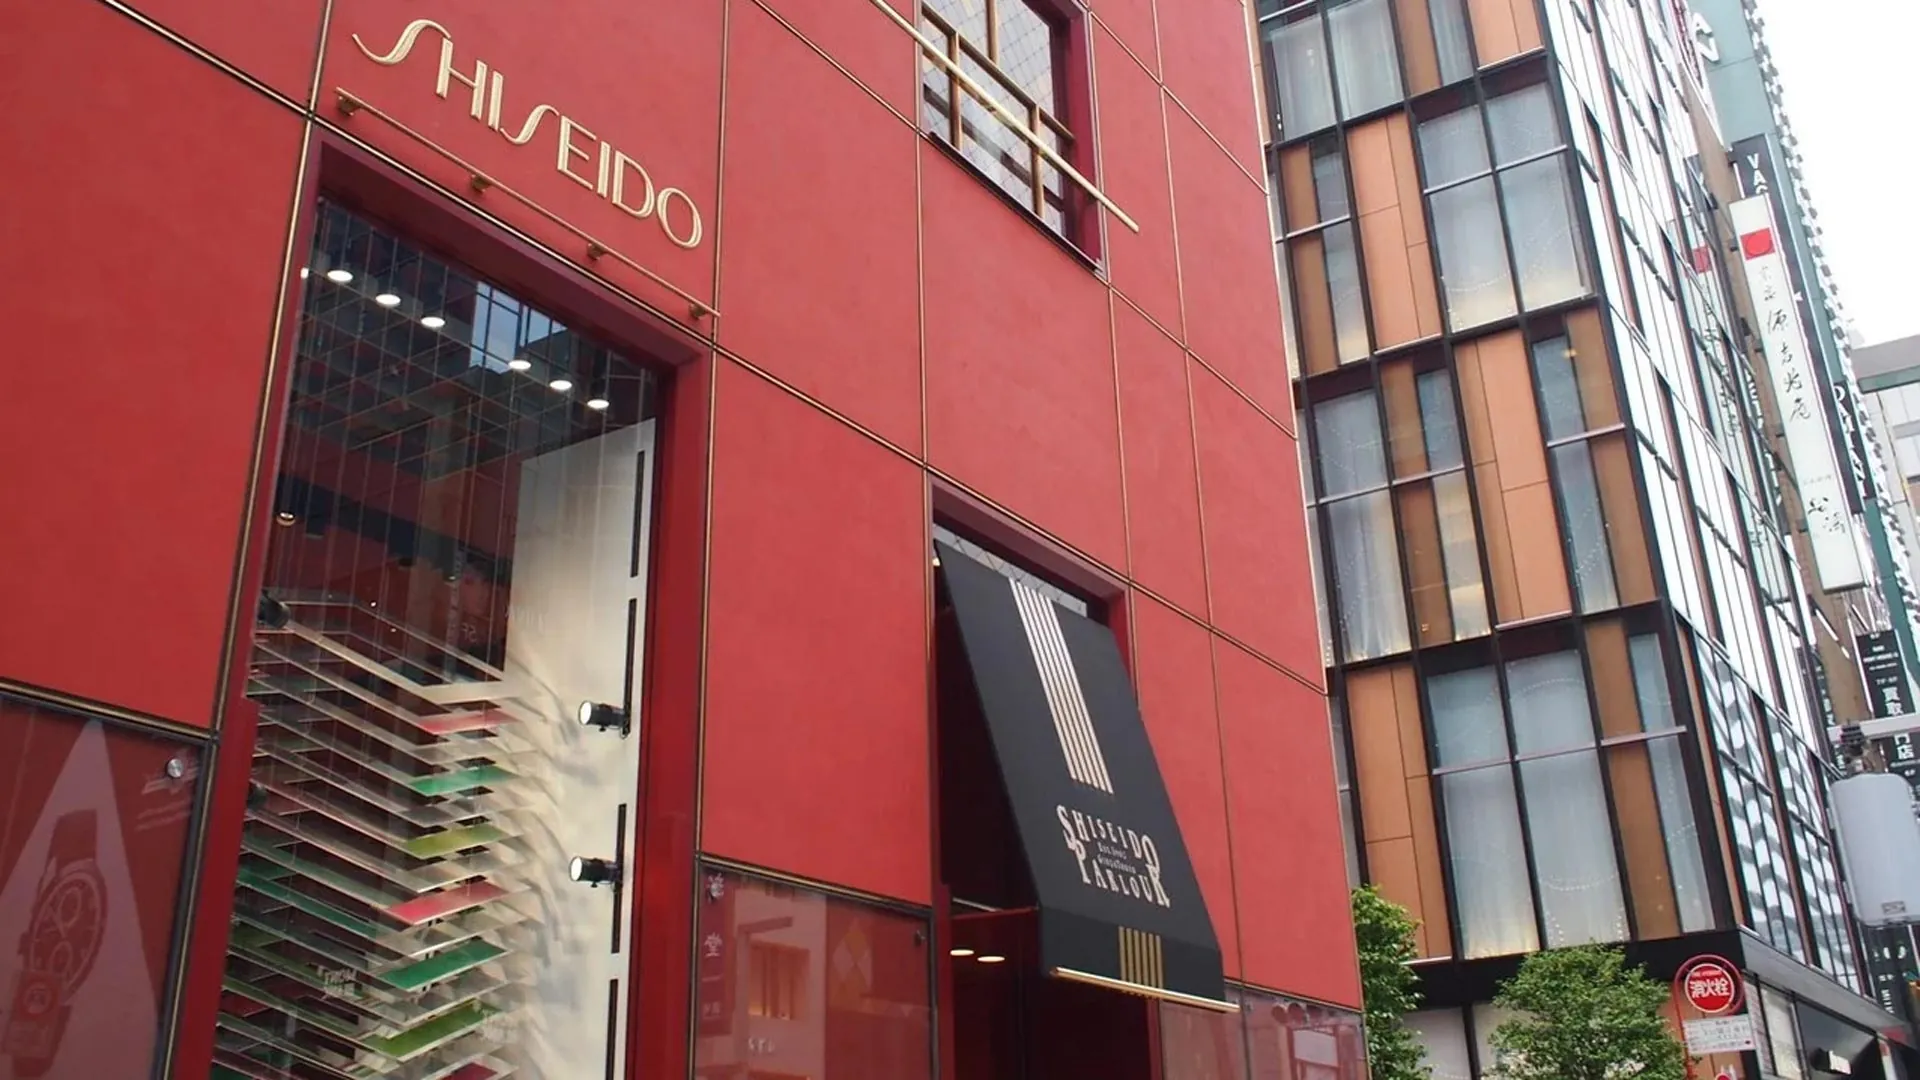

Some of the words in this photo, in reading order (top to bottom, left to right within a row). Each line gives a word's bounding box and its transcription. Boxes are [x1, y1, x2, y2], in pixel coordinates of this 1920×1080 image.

[352, 19, 703, 249] SHISEIDO
[1056, 804, 1160, 875] SHISEIDO
[1074, 839, 1170, 908] PARLOUR
[1689, 978, 1730, 998] 消火栓
